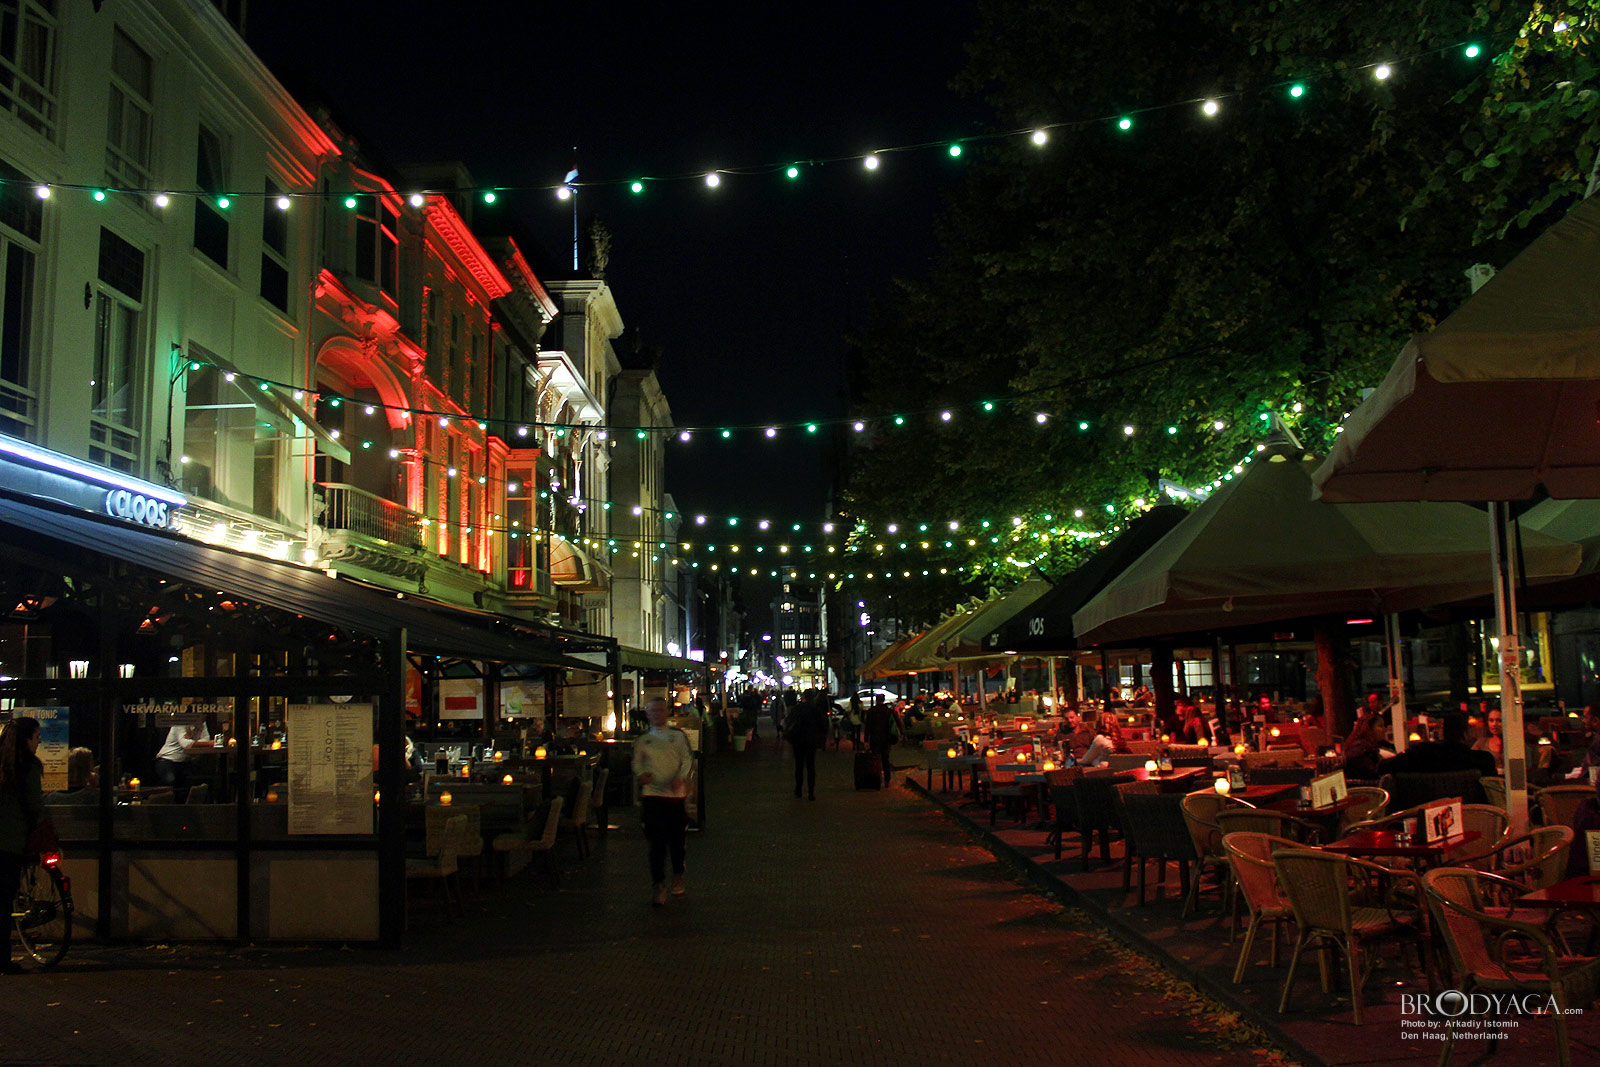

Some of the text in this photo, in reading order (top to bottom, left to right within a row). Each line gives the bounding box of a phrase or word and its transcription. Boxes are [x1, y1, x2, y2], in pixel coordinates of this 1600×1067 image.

[123, 703, 231, 713] VERWARMD TERRAS
[38, 709, 58, 719] TONIC
